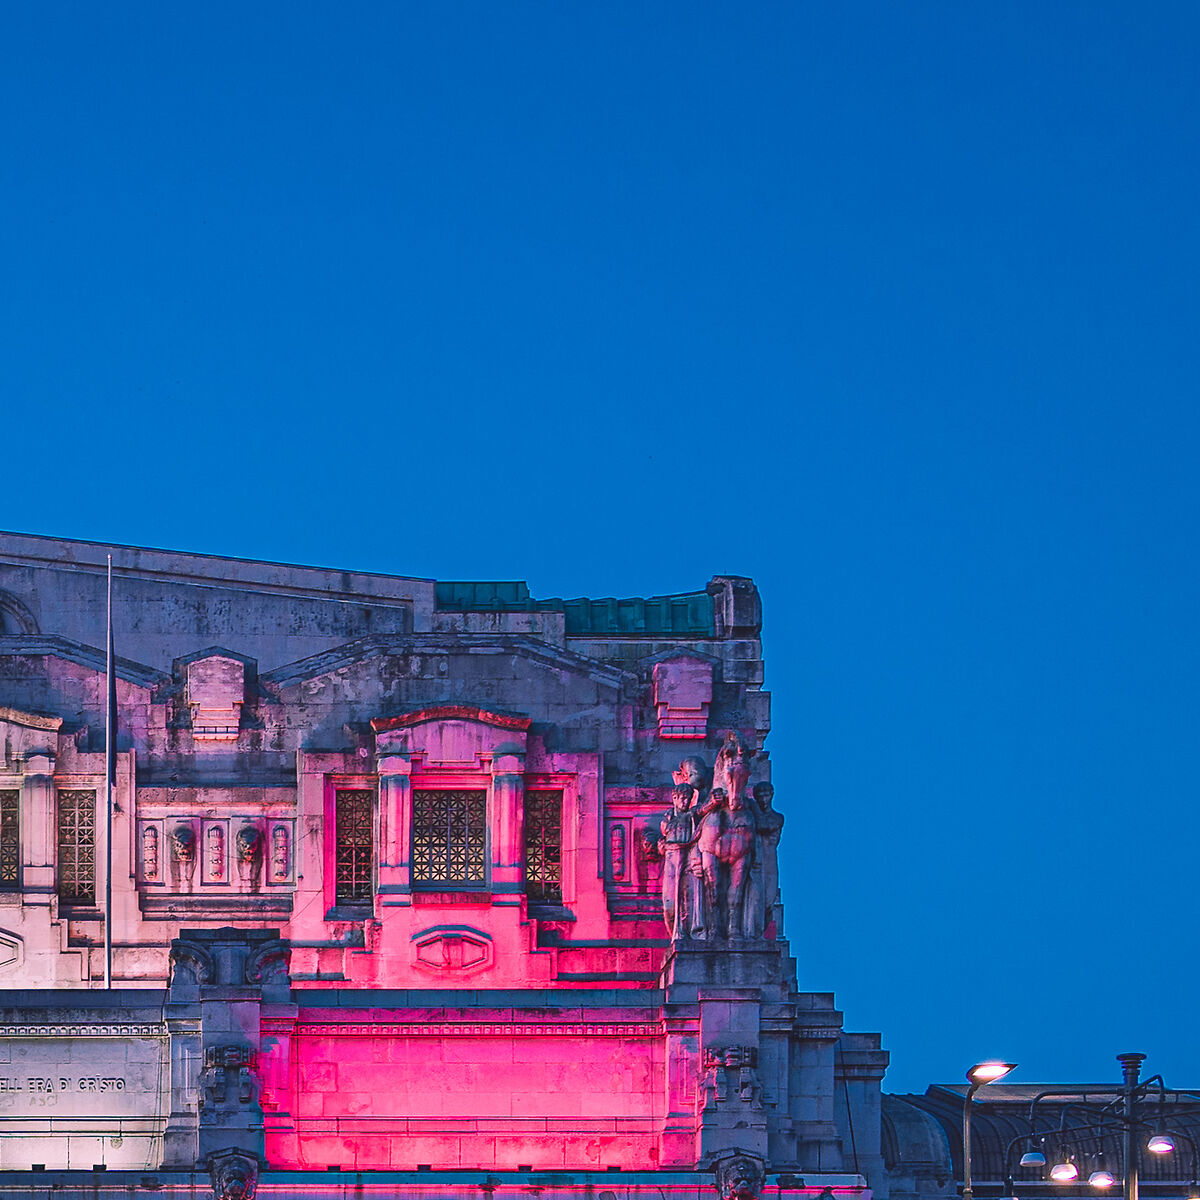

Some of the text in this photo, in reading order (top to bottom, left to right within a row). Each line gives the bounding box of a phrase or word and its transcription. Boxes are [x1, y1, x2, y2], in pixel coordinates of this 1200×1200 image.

[27, 1077, 54, 1092] ERA
[59, 1077, 72, 1092] DI
[77, 1077, 126, 1092] CRISTO
